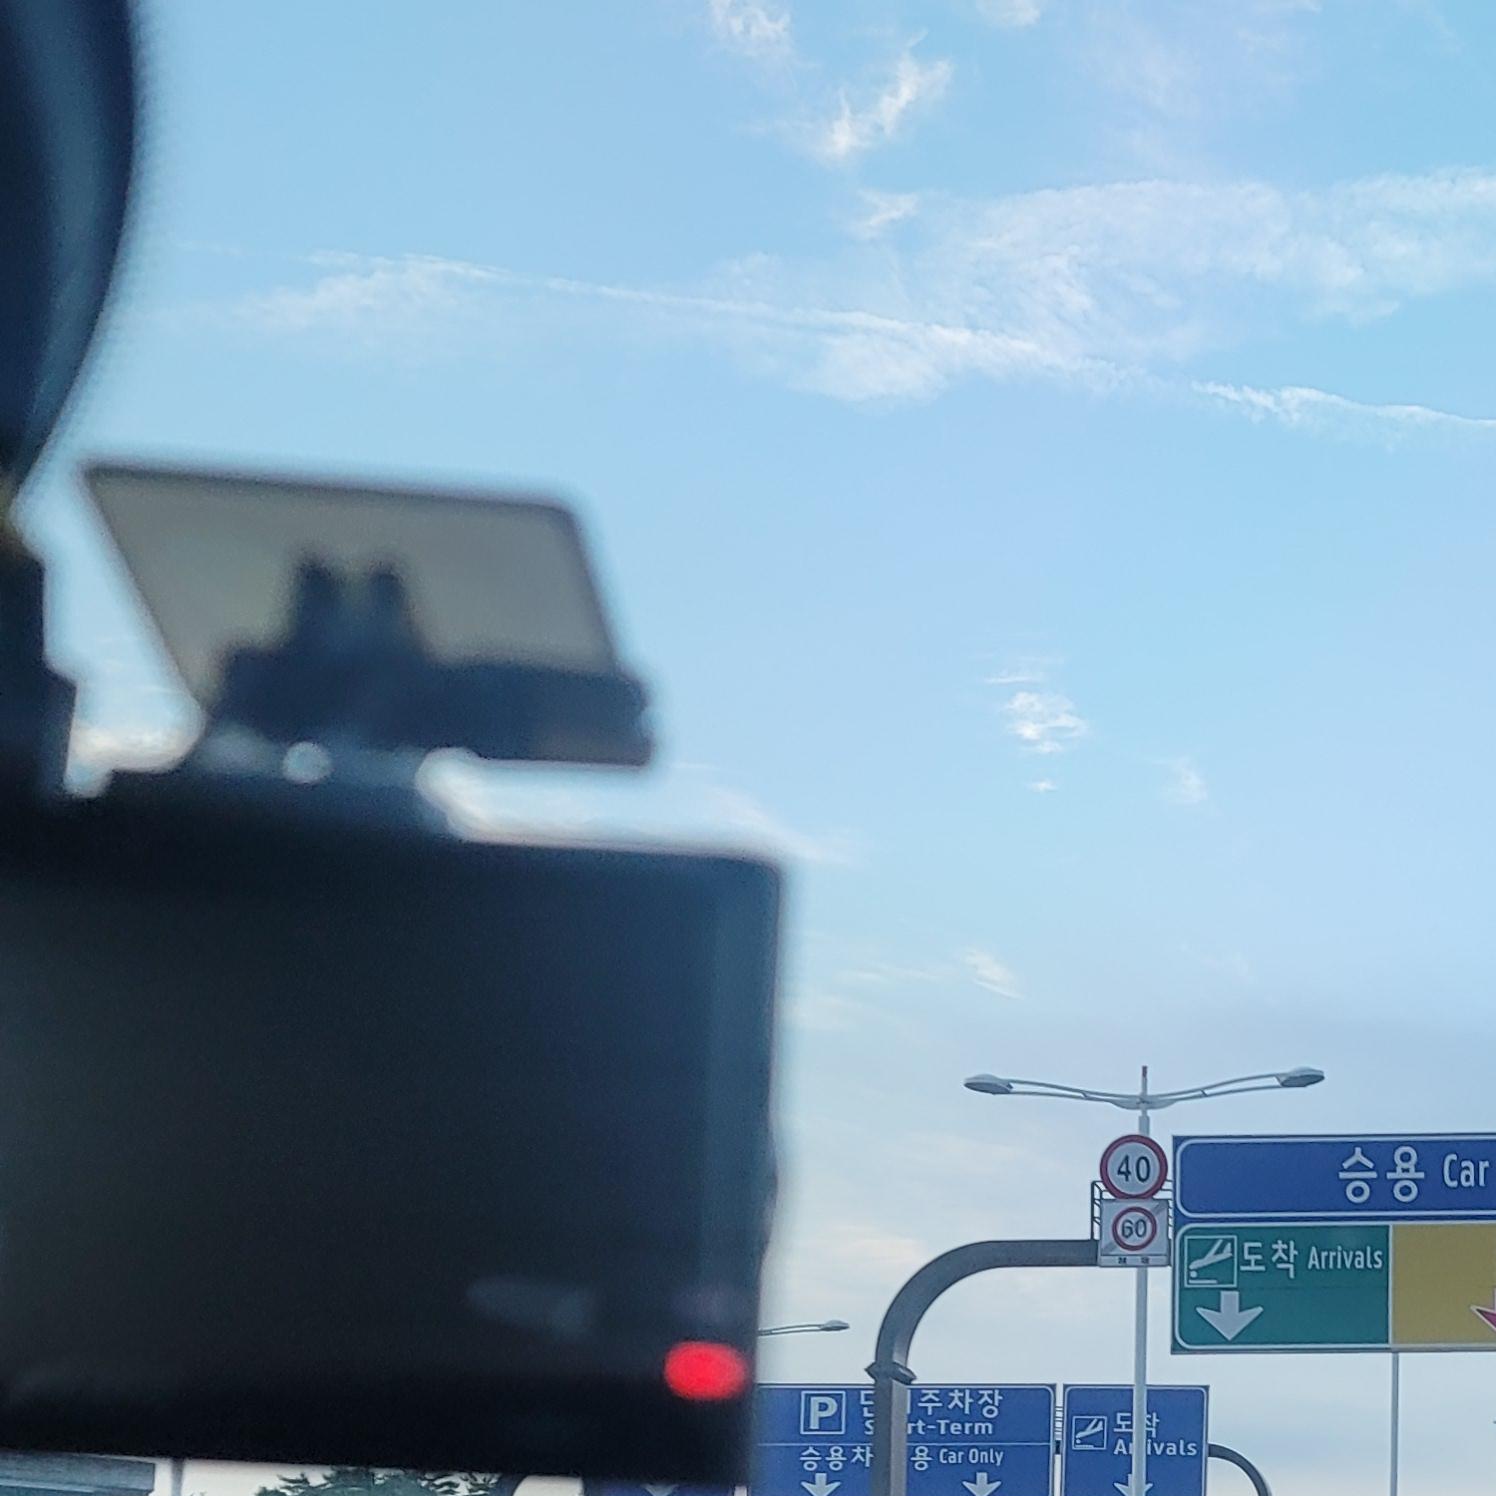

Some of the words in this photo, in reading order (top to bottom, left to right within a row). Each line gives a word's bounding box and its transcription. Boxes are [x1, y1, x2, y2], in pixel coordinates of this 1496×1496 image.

[1116, 1154, 1151, 1183] 40
[1338, 1145, 1425, 1203] 승용
[1442, 1153, 1490, 1188] Car
[1120, 1218, 1147, 1238] 60
[1240, 1240, 1298, 1279] 도착
[1308, 1246, 1384, 1271] Arrivals
[809, 1396, 838, 1430] P
[864, 1419, 994, 1436] Srt-Term
[939, 1449, 963, 1464] Car
[968, 1448, 1004, 1466] Only
